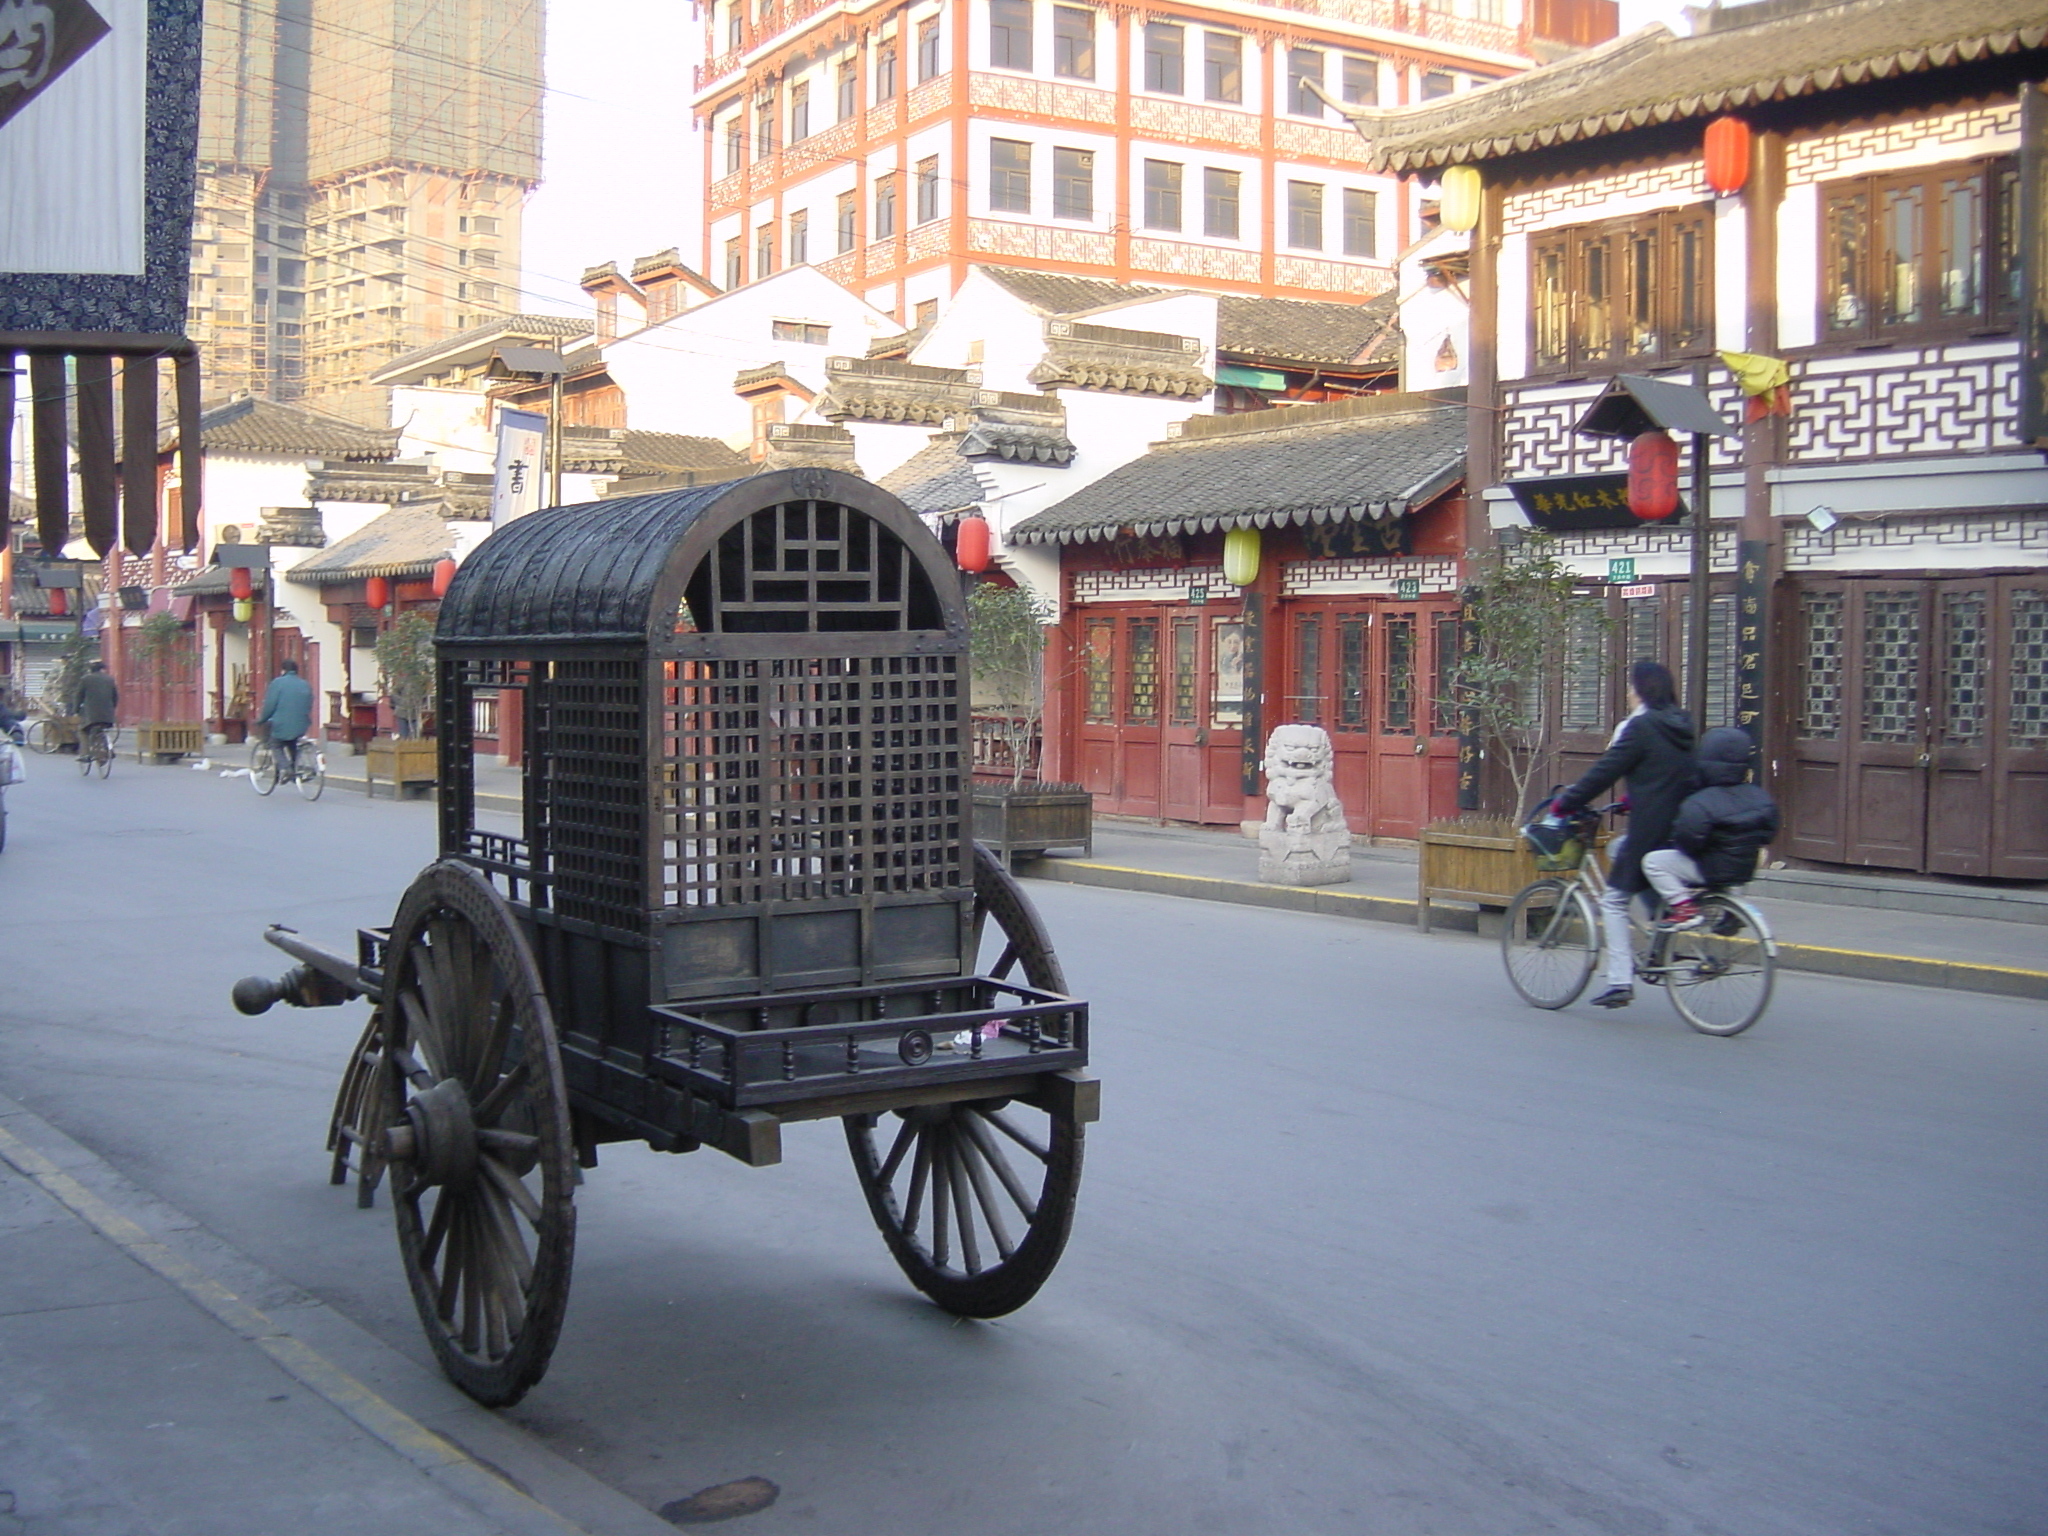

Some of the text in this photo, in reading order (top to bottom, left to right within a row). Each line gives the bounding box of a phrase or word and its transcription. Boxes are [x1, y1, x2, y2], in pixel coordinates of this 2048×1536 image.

[1612, 561, 1631, 574] 421
[1400, 581, 1417, 593] 423
[1190, 588, 1205, 599] 425
